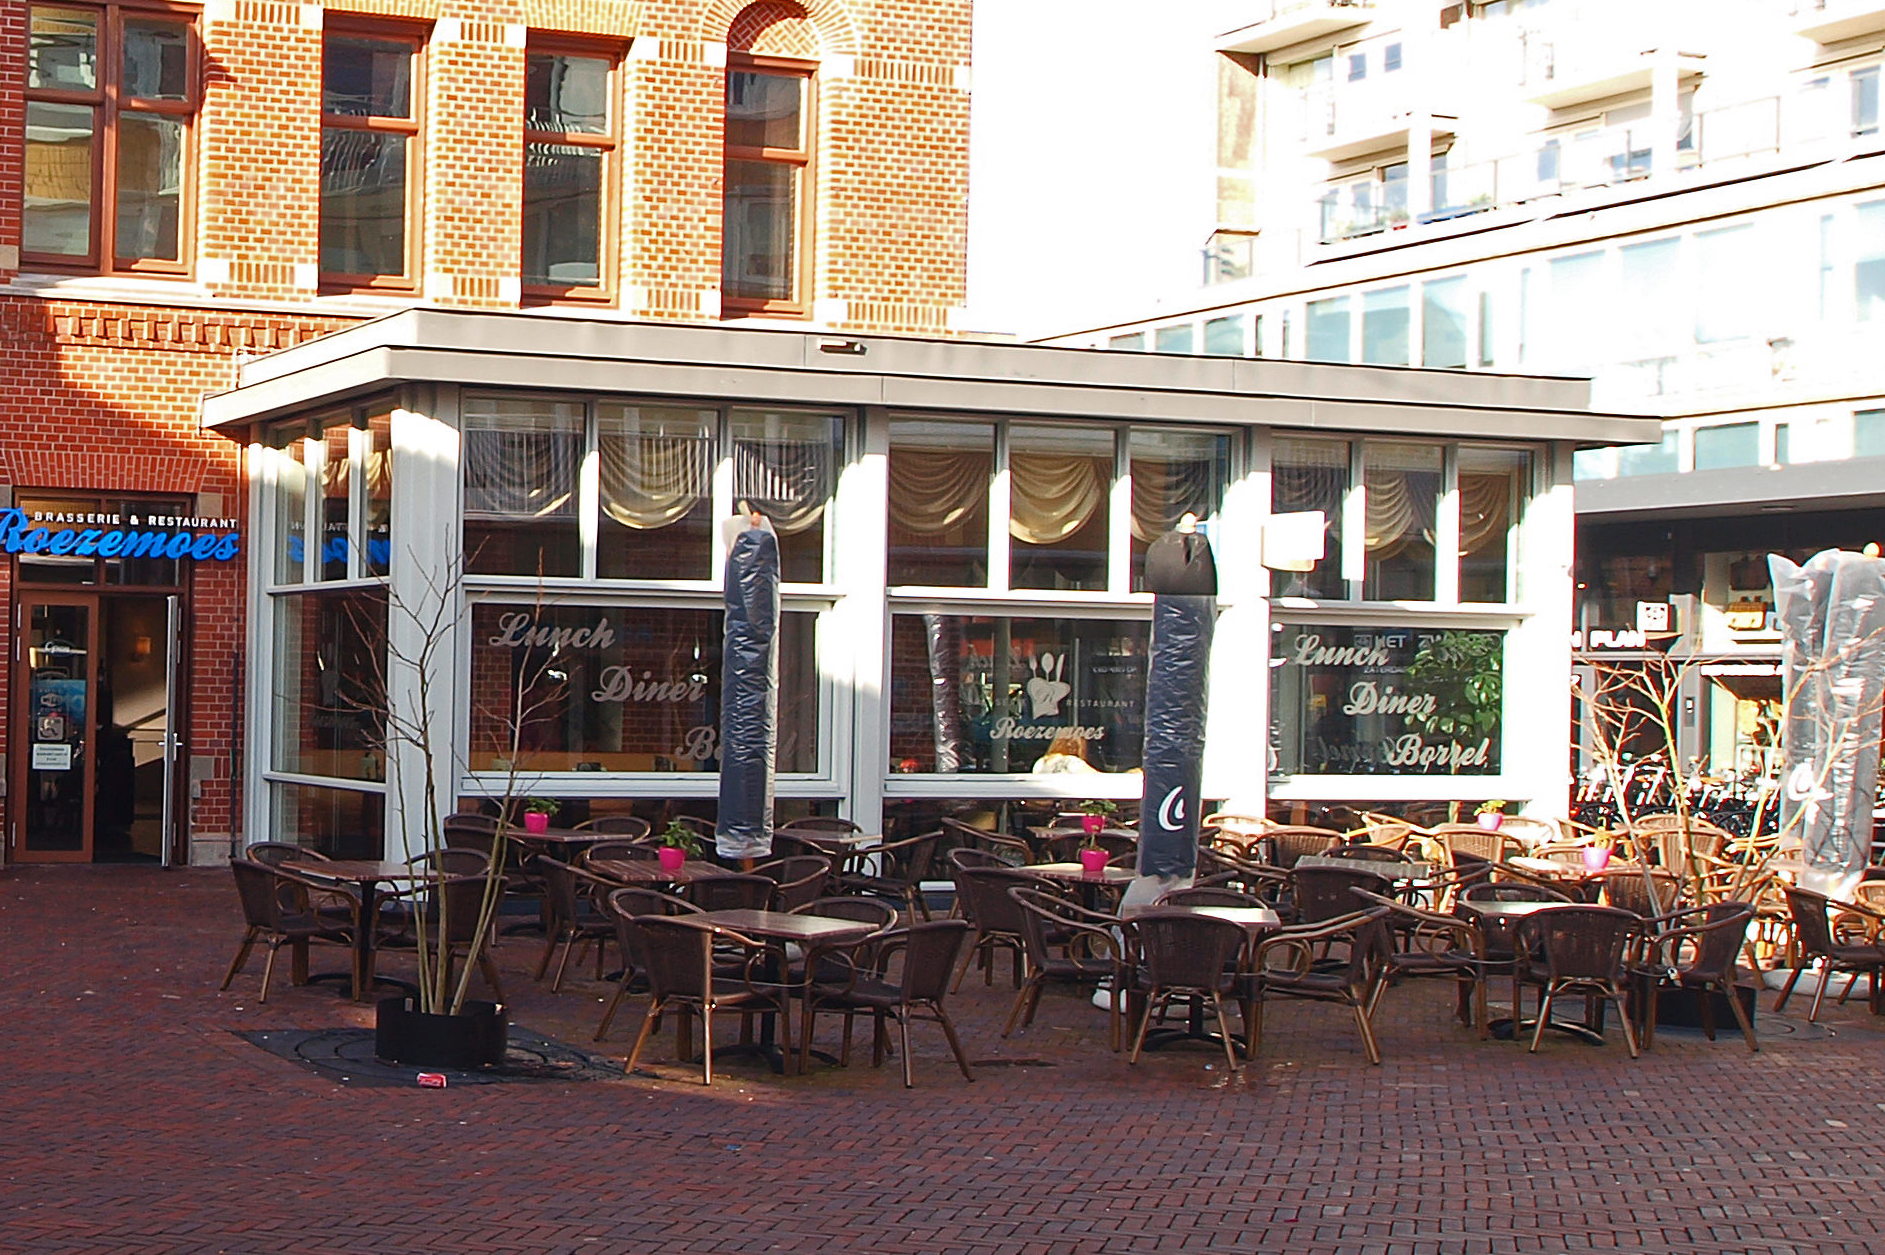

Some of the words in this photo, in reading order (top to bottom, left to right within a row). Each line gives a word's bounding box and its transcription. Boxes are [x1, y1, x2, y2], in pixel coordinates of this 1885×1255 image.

[34, 511, 120, 525] BRASSERIE
[130, 514, 139, 525] &
[148, 515, 237, 528] RESTAURANT
[489, 612, 616, 649] Lunch
[1294, 633, 1391, 667] Lunch
[591, 665, 706, 703] Diner
[1342, 681, 1437, 715] Diner
[1066, 699, 1136, 708] RSTAURANT
[990, 717, 1105, 740] Roezemoes
[1386, 732, 1492, 768] Borrel
